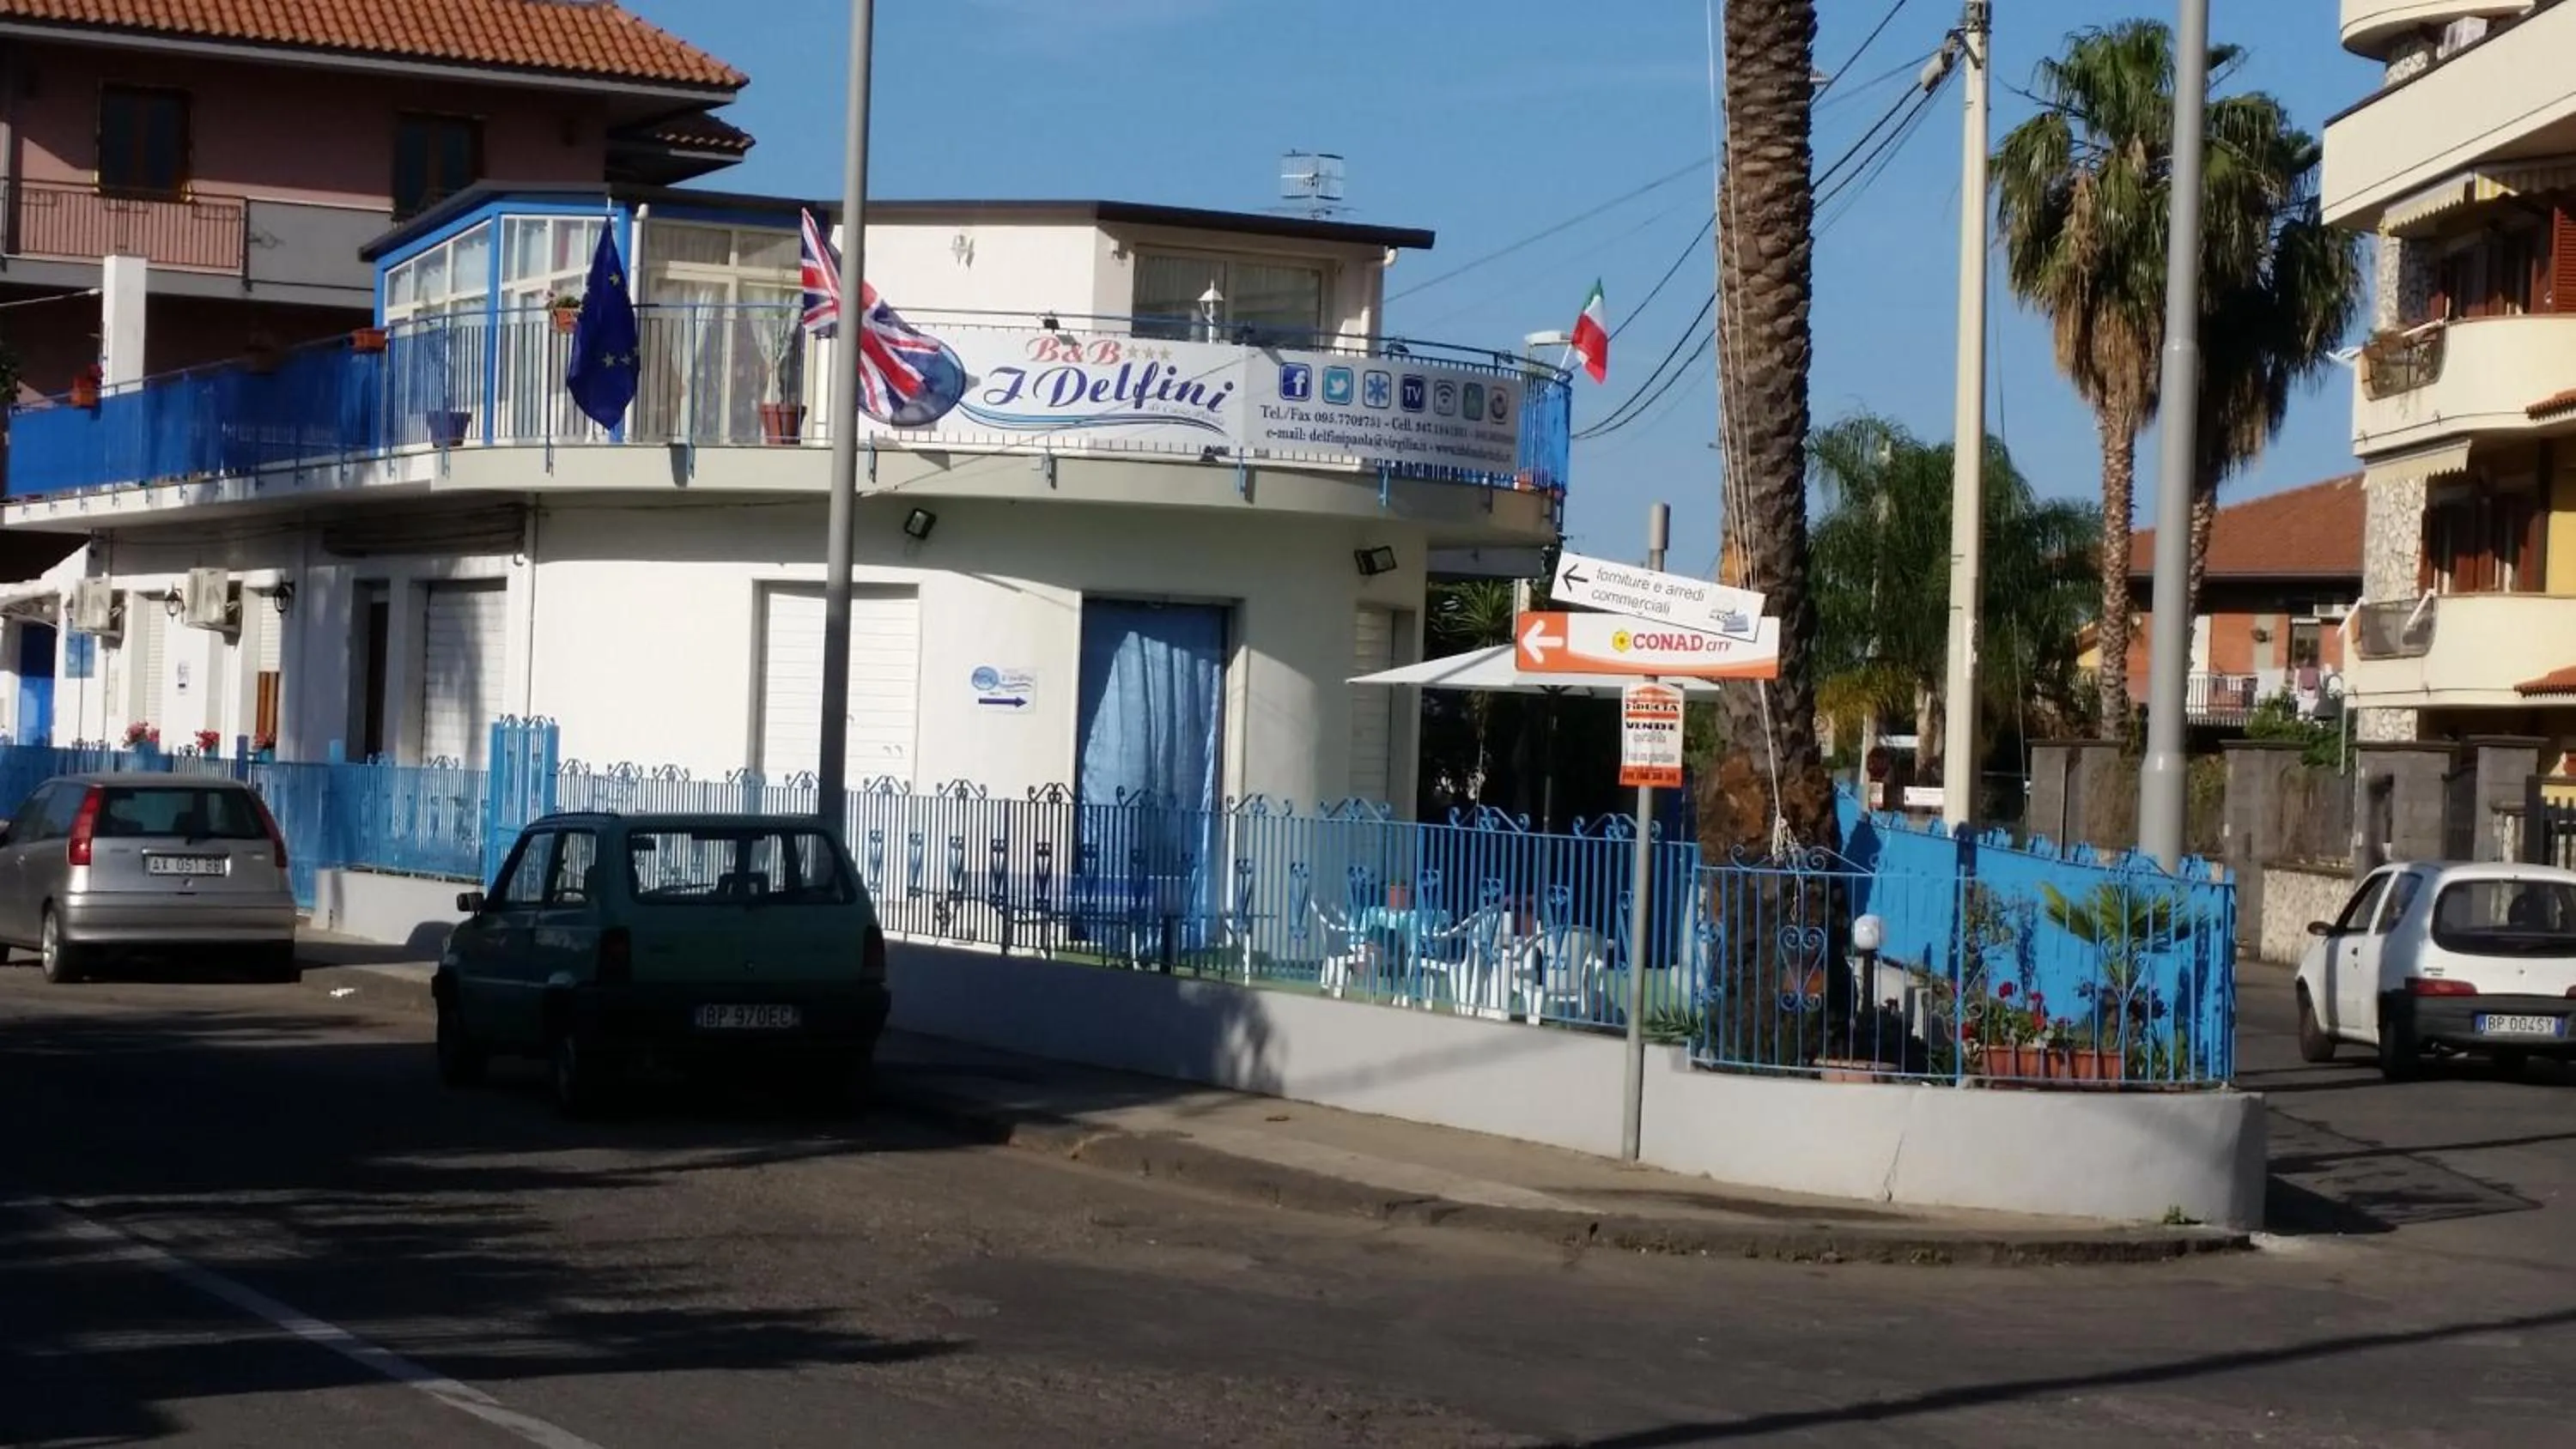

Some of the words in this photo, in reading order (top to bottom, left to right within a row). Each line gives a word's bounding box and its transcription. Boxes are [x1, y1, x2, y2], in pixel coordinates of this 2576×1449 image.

[1026, 336, 1121, 366] B&B
[1033, 361, 1235, 412] Delfini
[1405, 385, 1422, 404] TV
[1596, 567, 1649, 591] forniture
[1665, 583, 1705, 602] arredi
[1591, 589, 1670, 615] commerciali
[1632, 633, 1704, 652] CONAD
[706, 1003, 727, 1026] BP
[2488, 1016, 2505, 1030] BP
